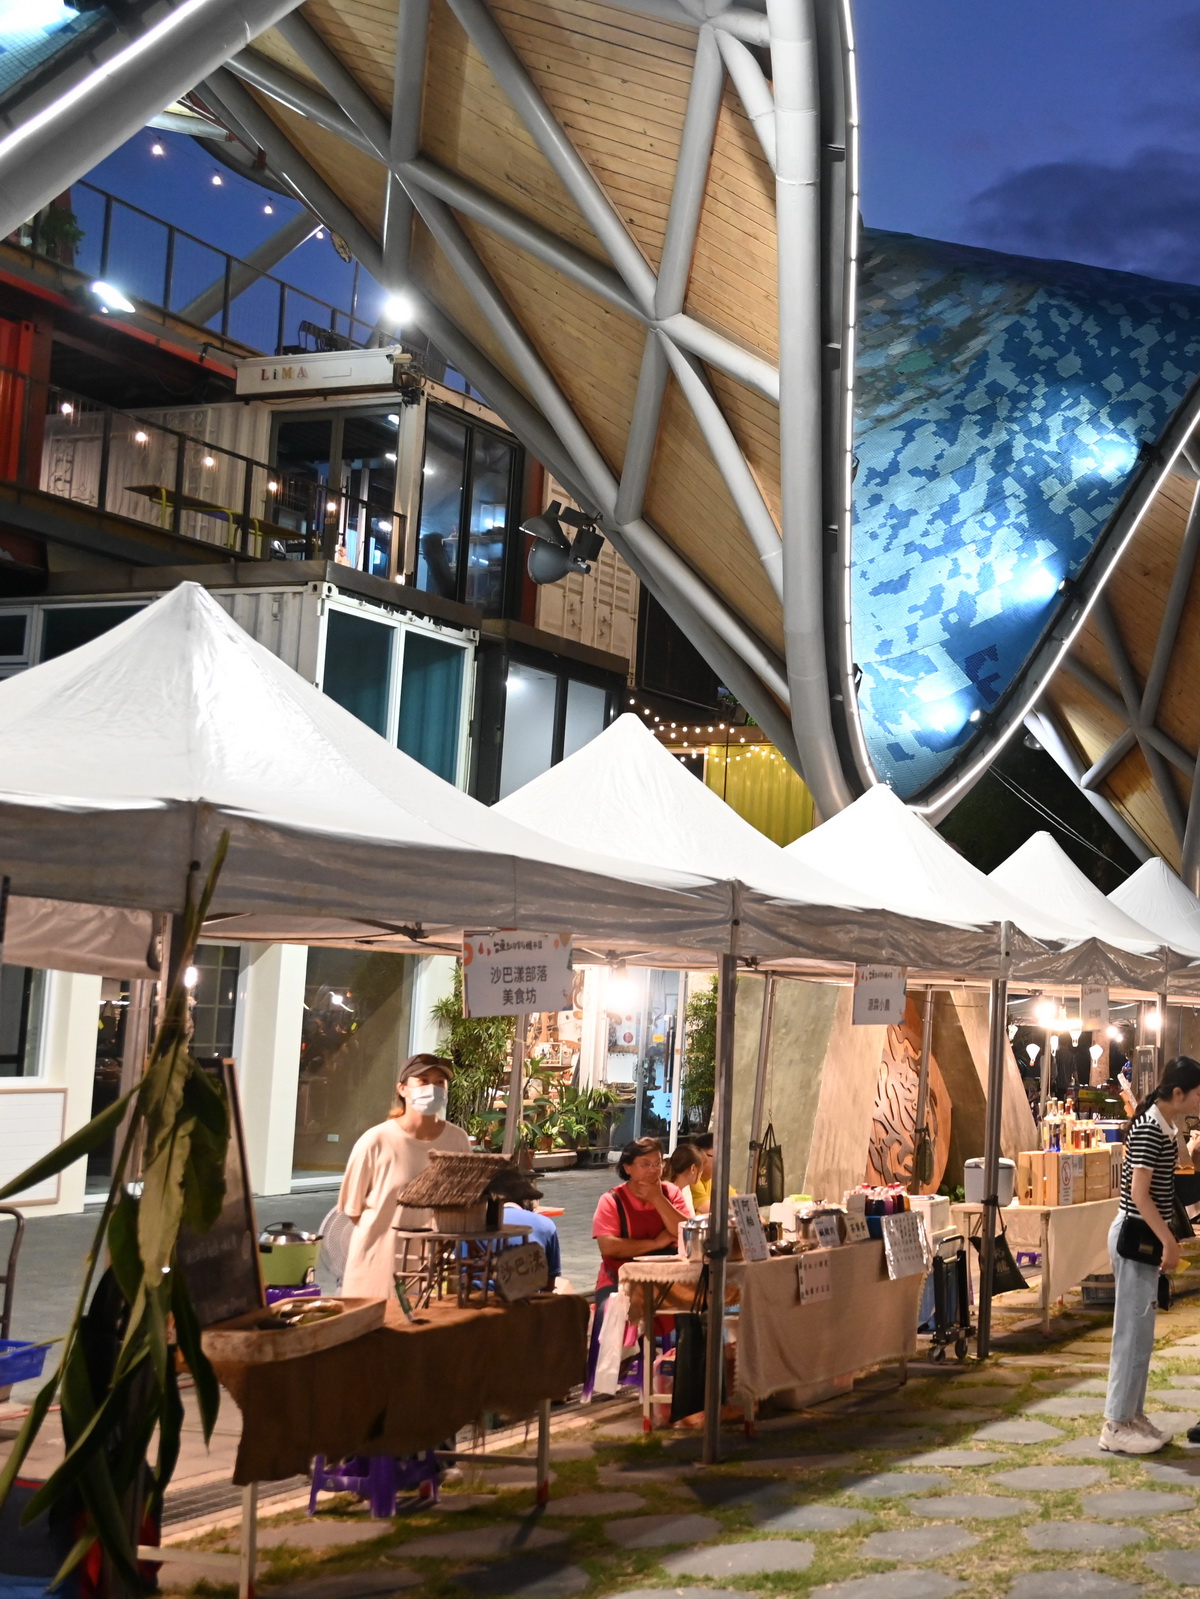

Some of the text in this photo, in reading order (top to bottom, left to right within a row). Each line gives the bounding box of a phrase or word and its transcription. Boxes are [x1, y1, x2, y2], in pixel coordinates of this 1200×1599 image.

[260, 366, 308, 381] LiMA
[490, 965, 548, 985] 沙巴漾部落
[502, 987, 537, 1006] 美食坊
